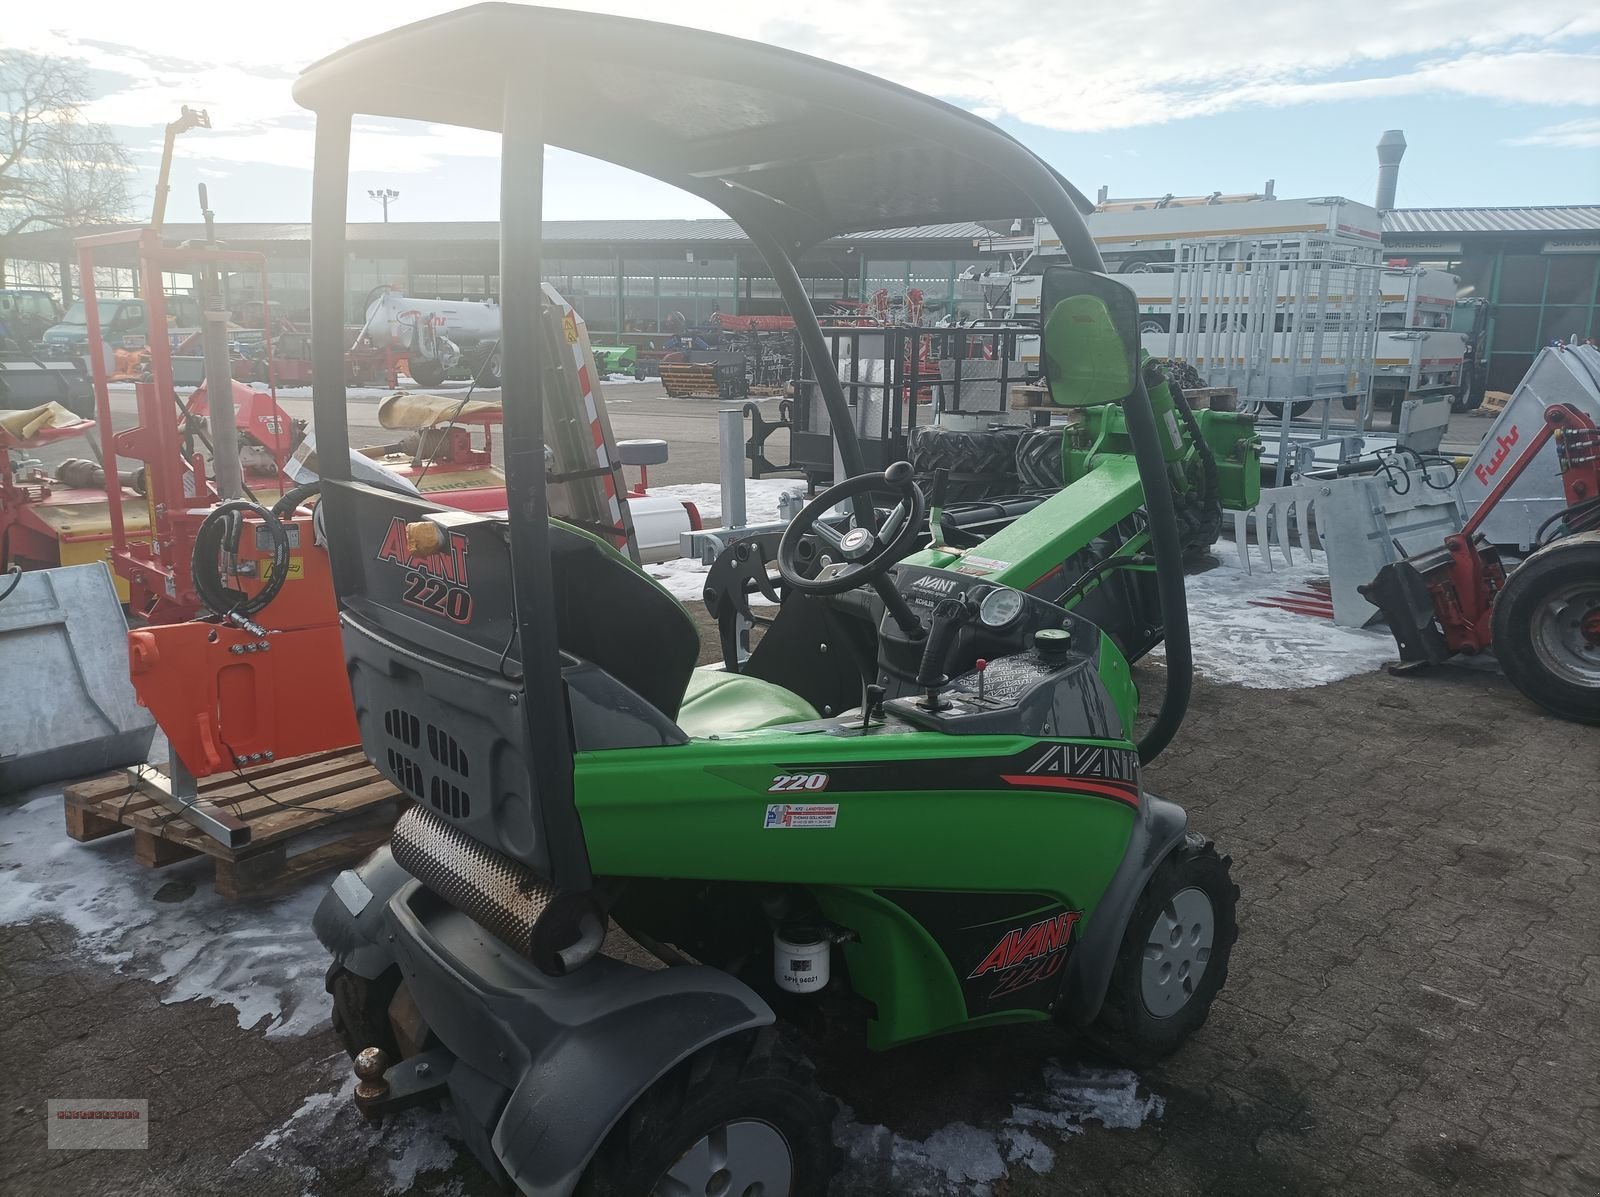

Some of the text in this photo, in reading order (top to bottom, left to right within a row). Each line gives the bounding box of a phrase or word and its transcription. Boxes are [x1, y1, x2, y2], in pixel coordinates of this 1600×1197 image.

[1474, 424, 1520, 486] Fuchs
[403, 571, 474, 625] 220
[911, 575, 957, 593] AVANT
[915, 598, 935, 608] KOHLER
[767, 772, 829, 793] 220
[1025, 745, 1139, 781] AVANT
[966, 911, 1083, 980] AVANT
[988, 947, 1068, 1000] 220
